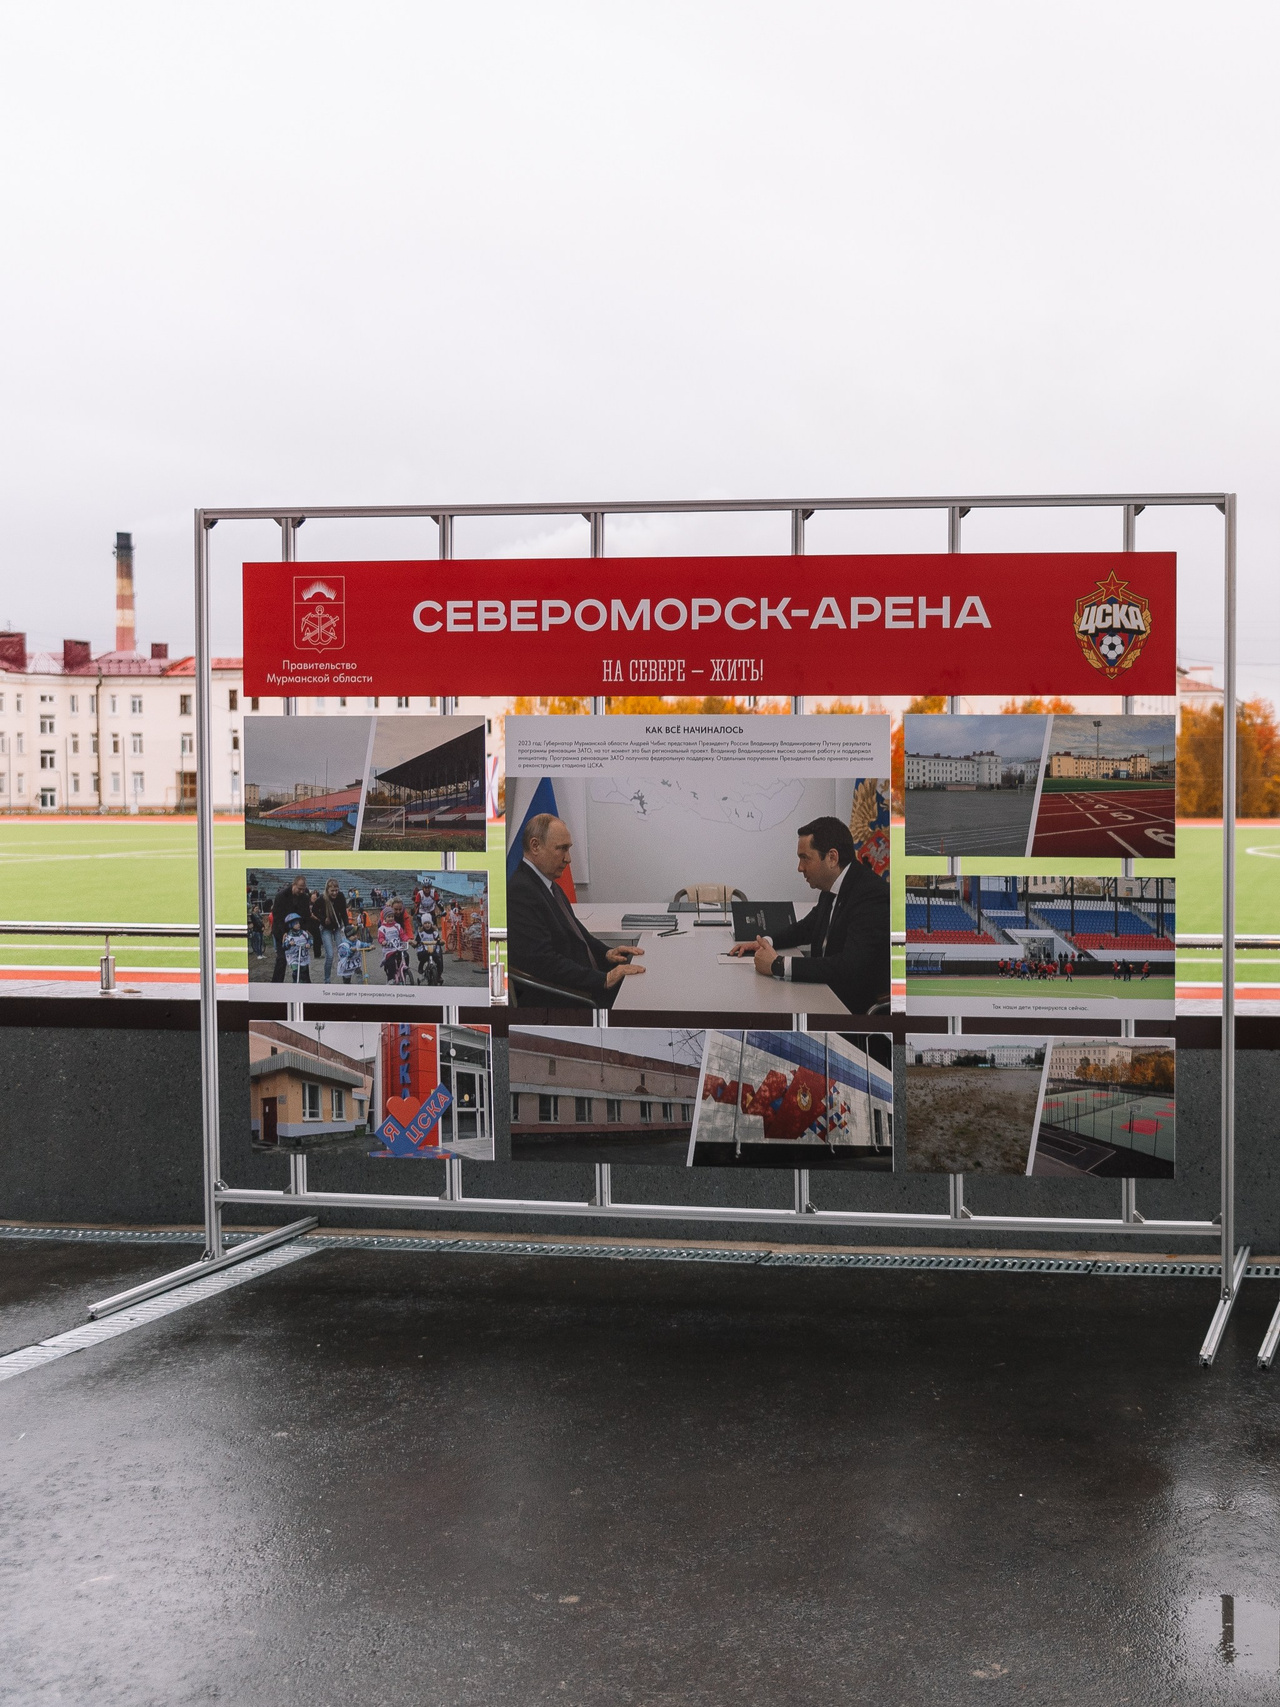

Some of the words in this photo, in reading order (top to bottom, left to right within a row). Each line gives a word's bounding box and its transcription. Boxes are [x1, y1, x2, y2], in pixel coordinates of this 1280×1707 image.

[412, 595, 992, 633] СЕВЕРОМОРСК-АРЕНА
[1079, 603, 1146, 634] ЦСКА
[282, 659, 357, 673] Правительство
[602, 659, 624, 682] НА
[629, 659, 686, 682] СЕВЕРЕ
[709, 658, 764, 682] ЖИТЬ!
[266, 673, 330, 686] Мурманской
[332, 673, 373, 683] области
[645, 726, 663, 734] КАК
[665, 725, 681, 734] ВСЁ
[683, 726, 744, 734] НАЧИНАЛОСЬ
[1109, 811, 1135, 821] 5
[383, 1121, 401, 1143] Я
[405, 1092, 450, 1144] ЦСКА
